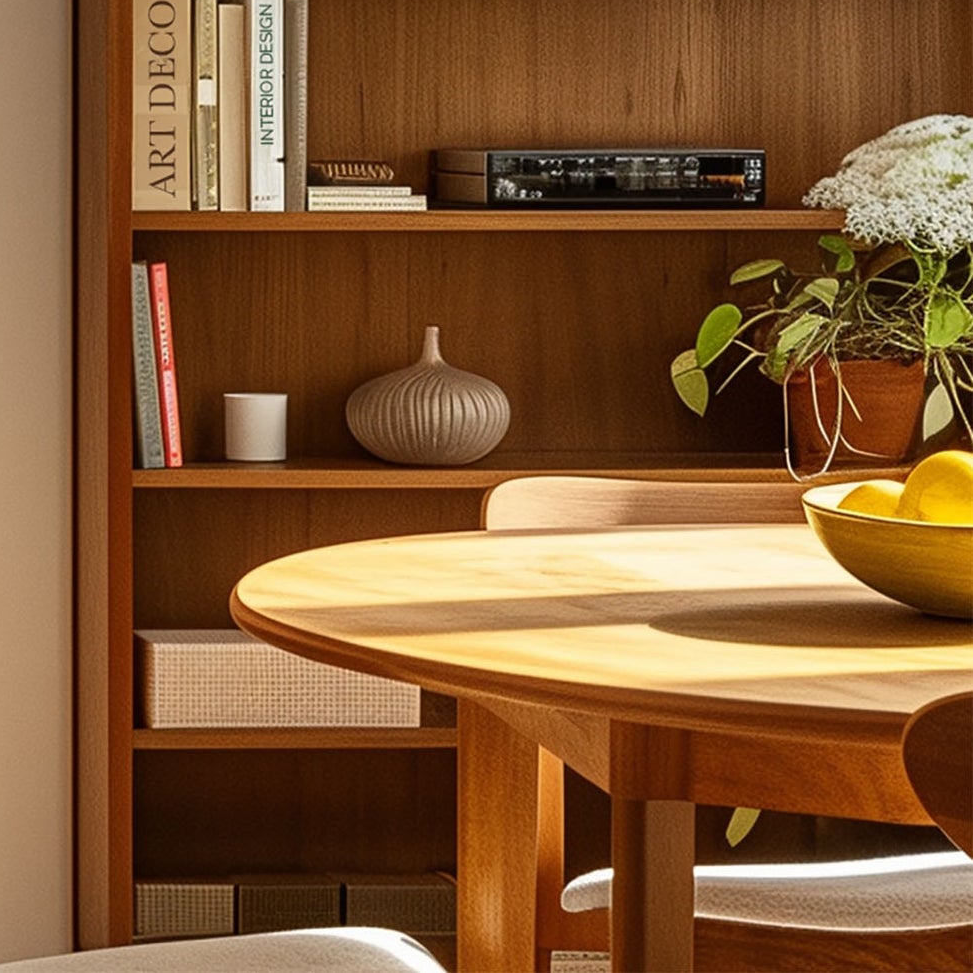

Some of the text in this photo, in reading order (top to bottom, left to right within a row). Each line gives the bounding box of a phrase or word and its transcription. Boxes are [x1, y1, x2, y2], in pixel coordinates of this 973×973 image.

[147, 0, 176, 197] ART DECO
[259, 4, 274, 145] INTERIOR DESIGN
